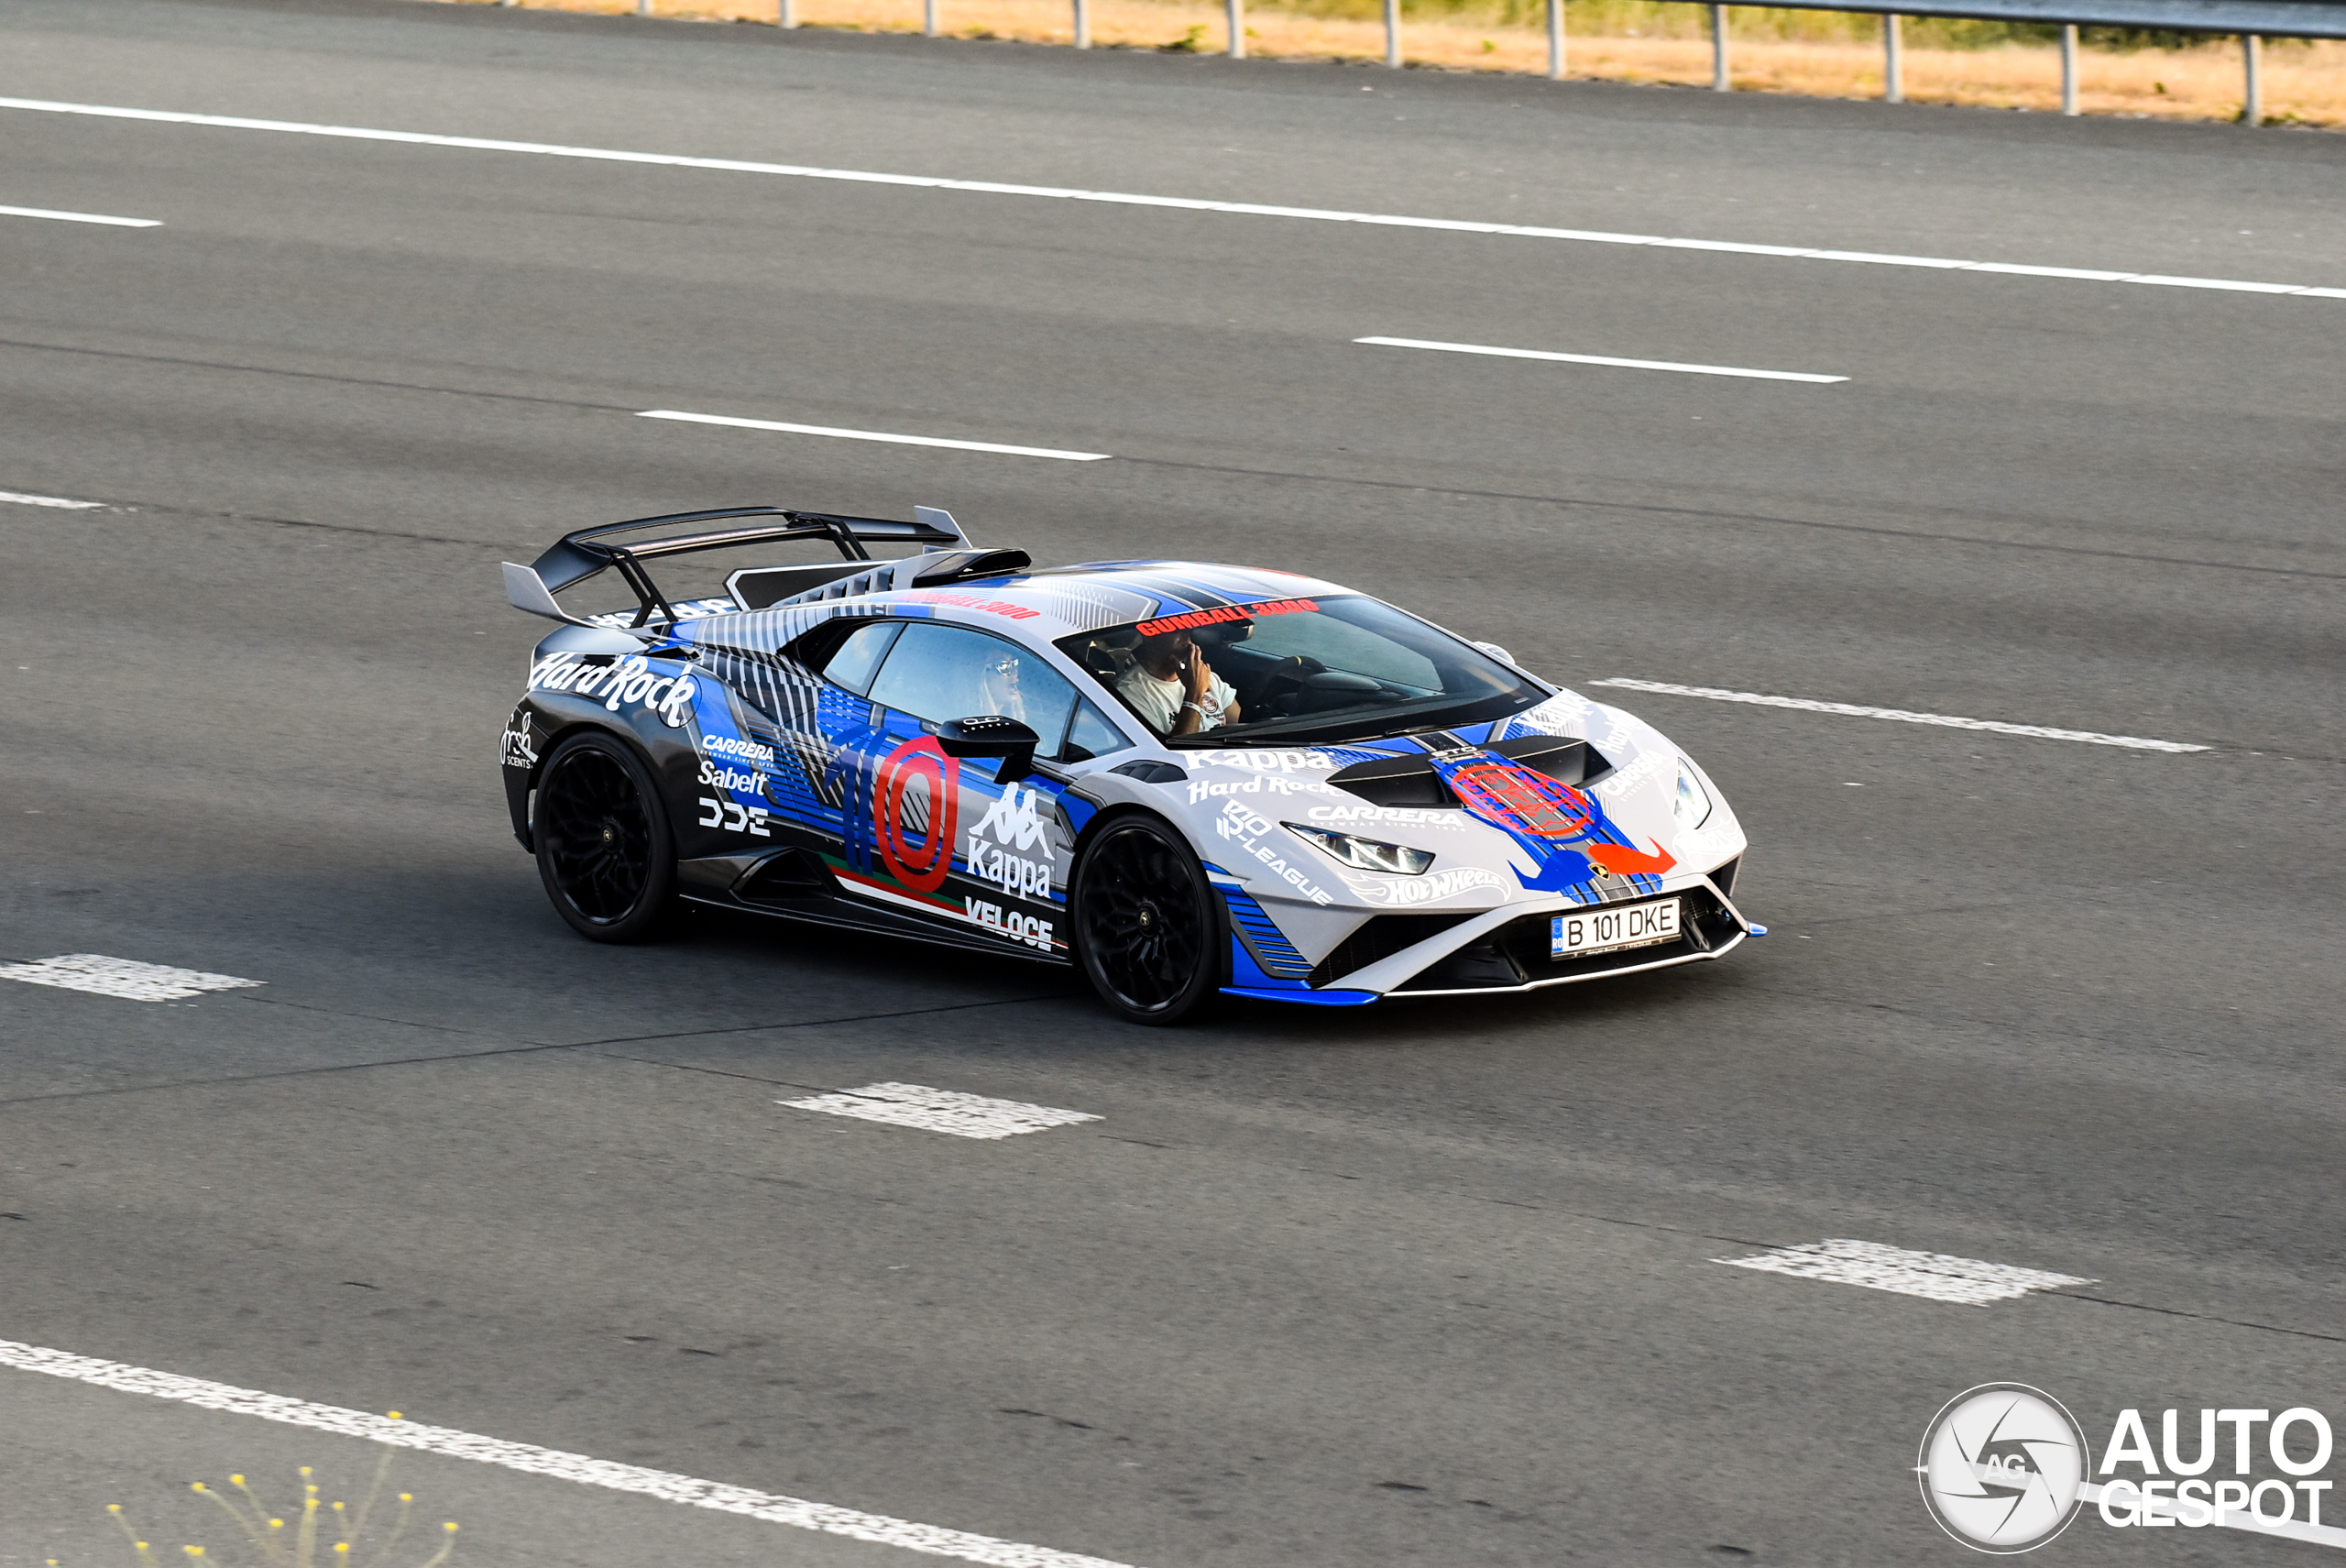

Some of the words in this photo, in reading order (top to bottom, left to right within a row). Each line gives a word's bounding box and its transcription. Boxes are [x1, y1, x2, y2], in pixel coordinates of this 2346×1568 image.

[975, 600, 1041, 620] 3000
[1135, 606, 1256, 637] GUMBALL
[1251, 598, 1321, 617] 3000
[529, 652, 623, 694] Hard
[599, 654, 696, 727] Rock
[507, 755, 531, 769] SCENTS
[702, 734, 774, 762] CARRERA
[1182, 750, 1334, 773] Kappa
[1431, 745, 1477, 757] STO
[697, 761, 767, 795] Sabelt
[1601, 749, 1669, 796] CARRERA
[1187, 775, 1262, 806] Hard
[1266, 776, 1342, 797] Rock
[1308, 806, 1465, 828] CARRERA
[967, 835, 1051, 900] Kappa
[964, 895, 1053, 952] VELOCE
[1568, 919, 1584, 948] B
[1593, 913, 1620, 942] 101
[1629, 904, 1673, 938] DKE
[1552, 938, 1562, 949] RO
